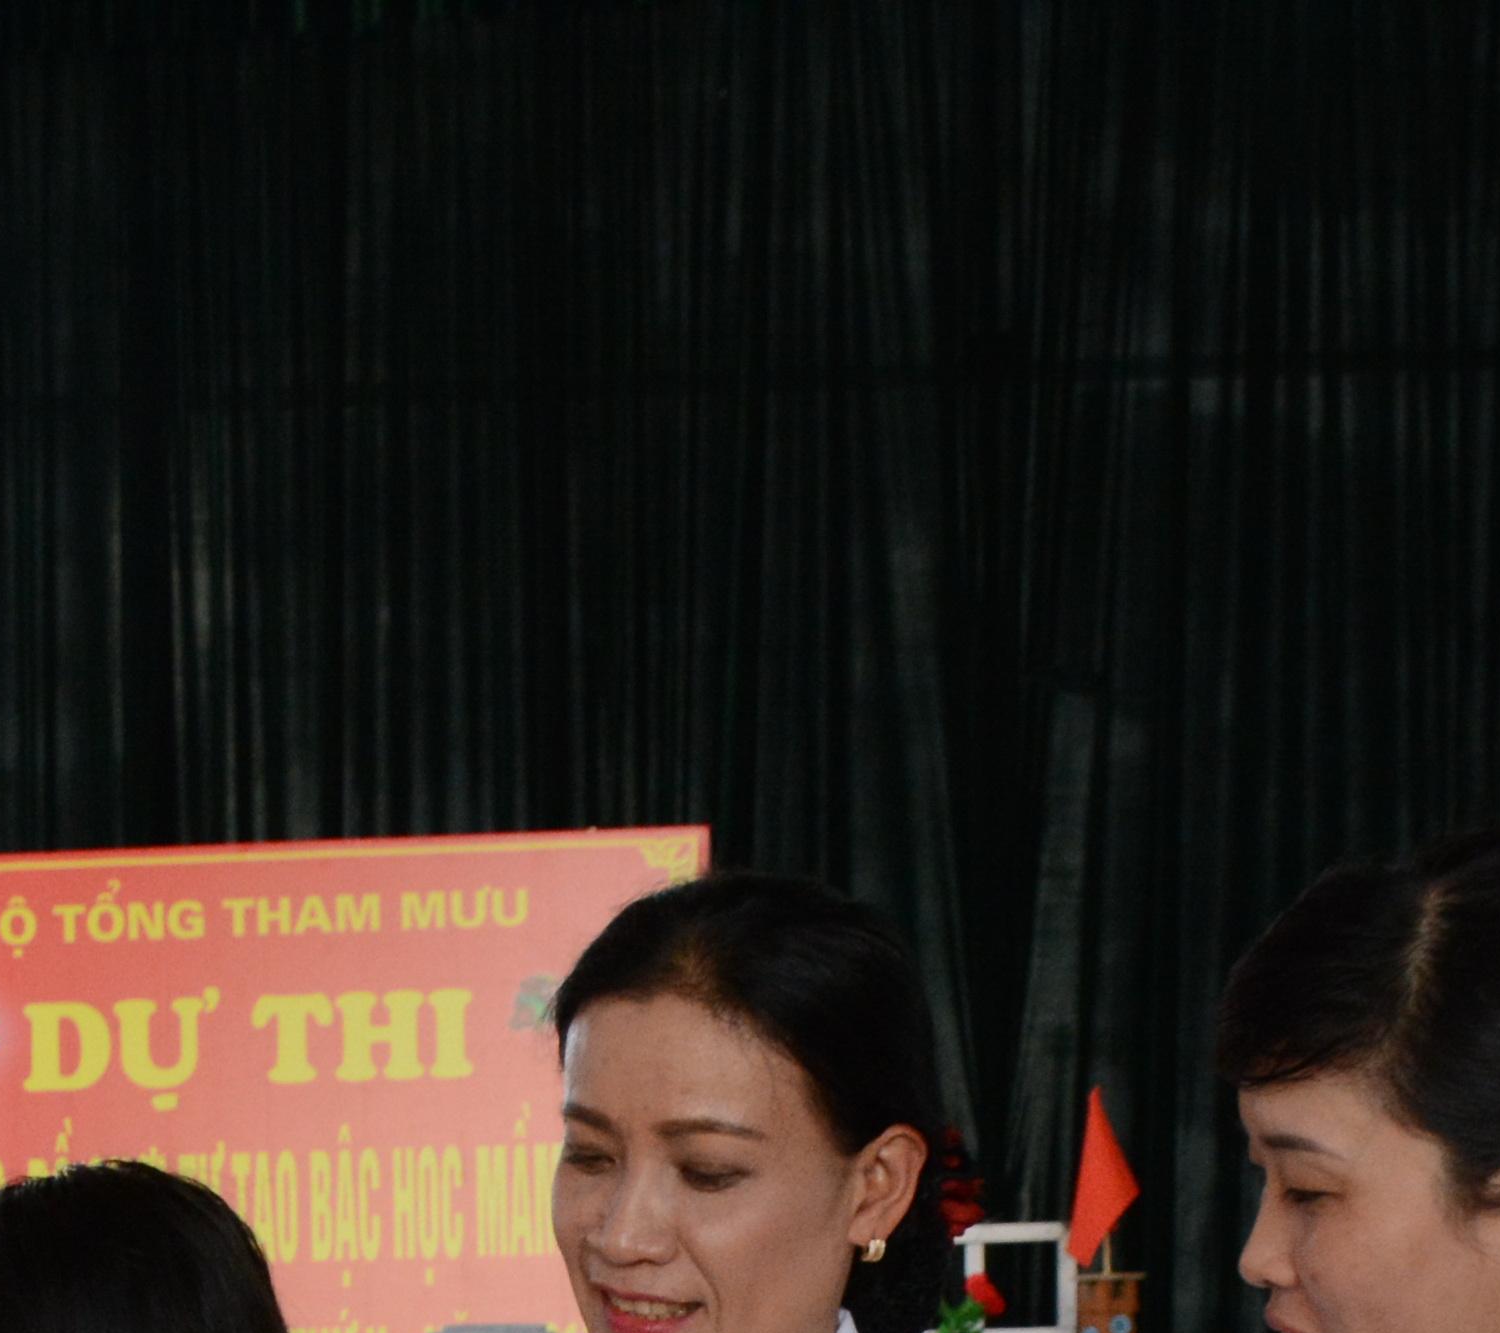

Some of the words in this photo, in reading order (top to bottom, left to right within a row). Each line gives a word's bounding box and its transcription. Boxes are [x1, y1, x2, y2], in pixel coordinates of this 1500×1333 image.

[53, 880, 204, 944] TỔNG
[223, 894, 381, 937] THAM
[401, 885, 529, 929] MƯU
[23, 987, 220, 1112] DỰ
[252, 988, 473, 1084] THI
[310, 1123, 381, 1287] BẬC
[393, 1145, 464, 1285] HỌC
